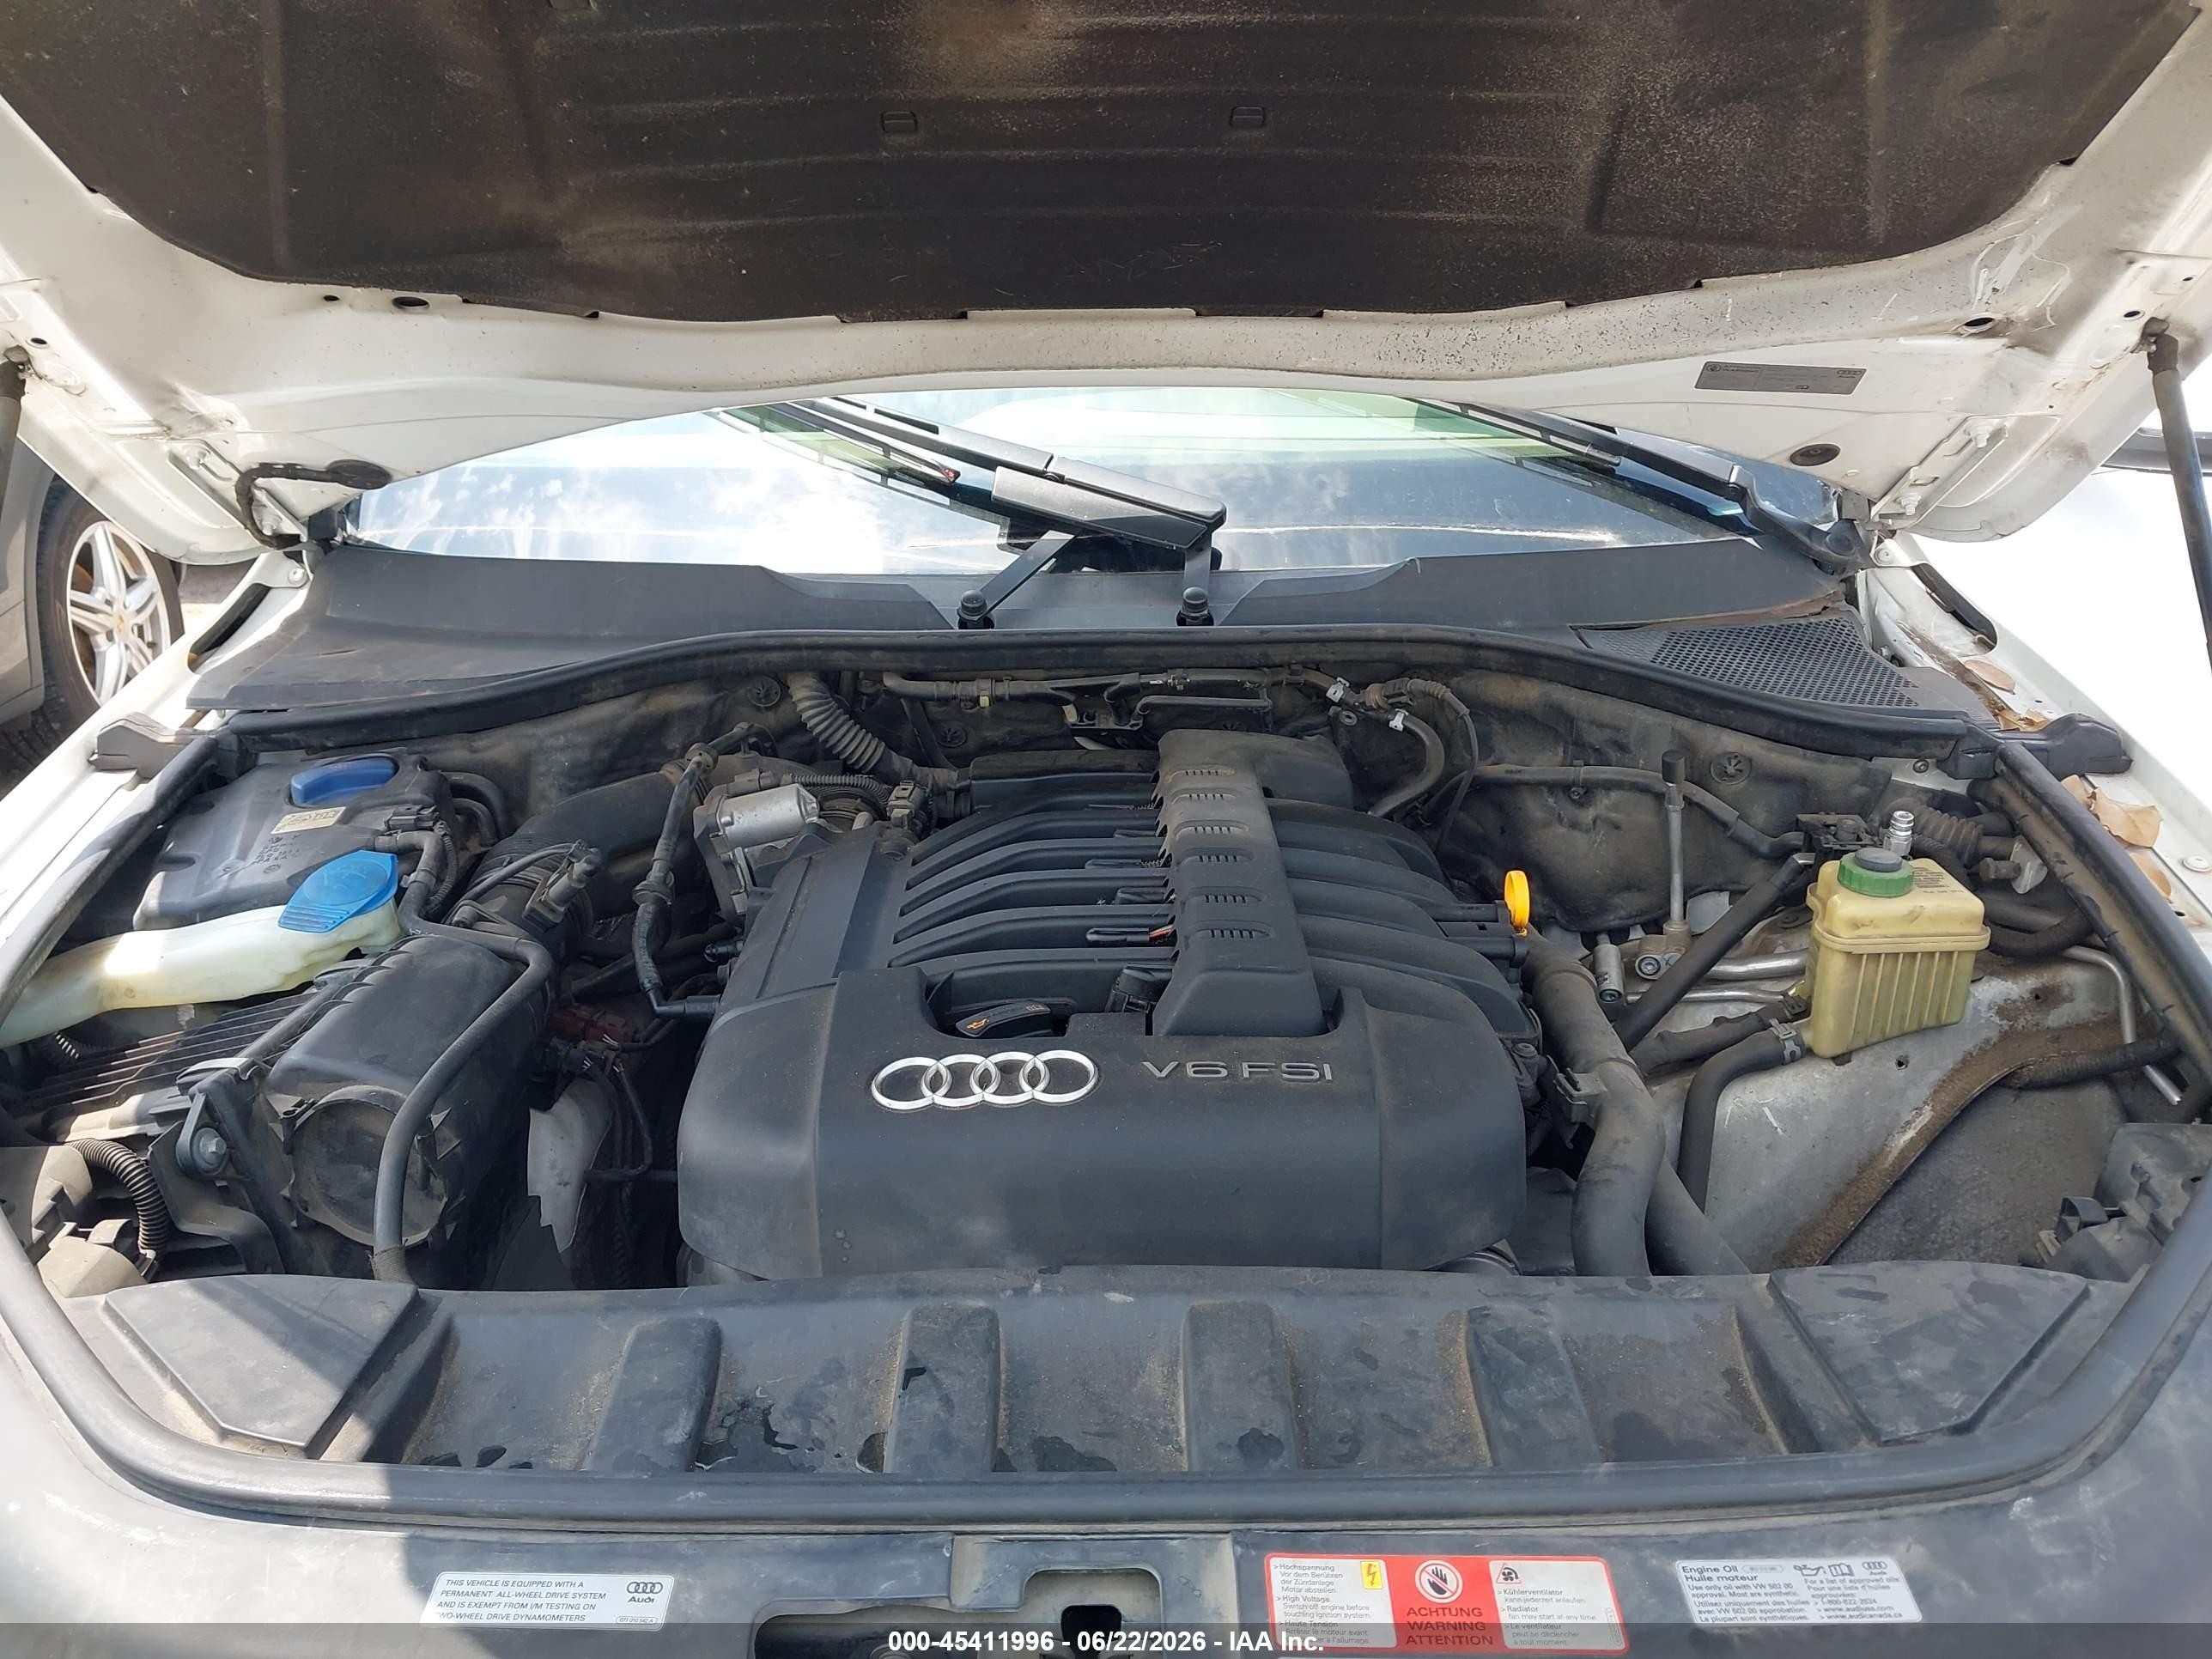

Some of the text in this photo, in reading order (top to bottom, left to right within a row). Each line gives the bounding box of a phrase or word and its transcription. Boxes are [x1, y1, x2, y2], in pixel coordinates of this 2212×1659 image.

[1141, 1061, 1333, 1079] V6 FSI
[1407, 1607, 1483, 1617] ACHTUNG
[1407, 1621, 1486, 1631] WARNING
[1407, 1635, 1493, 1645] ATTENTION
